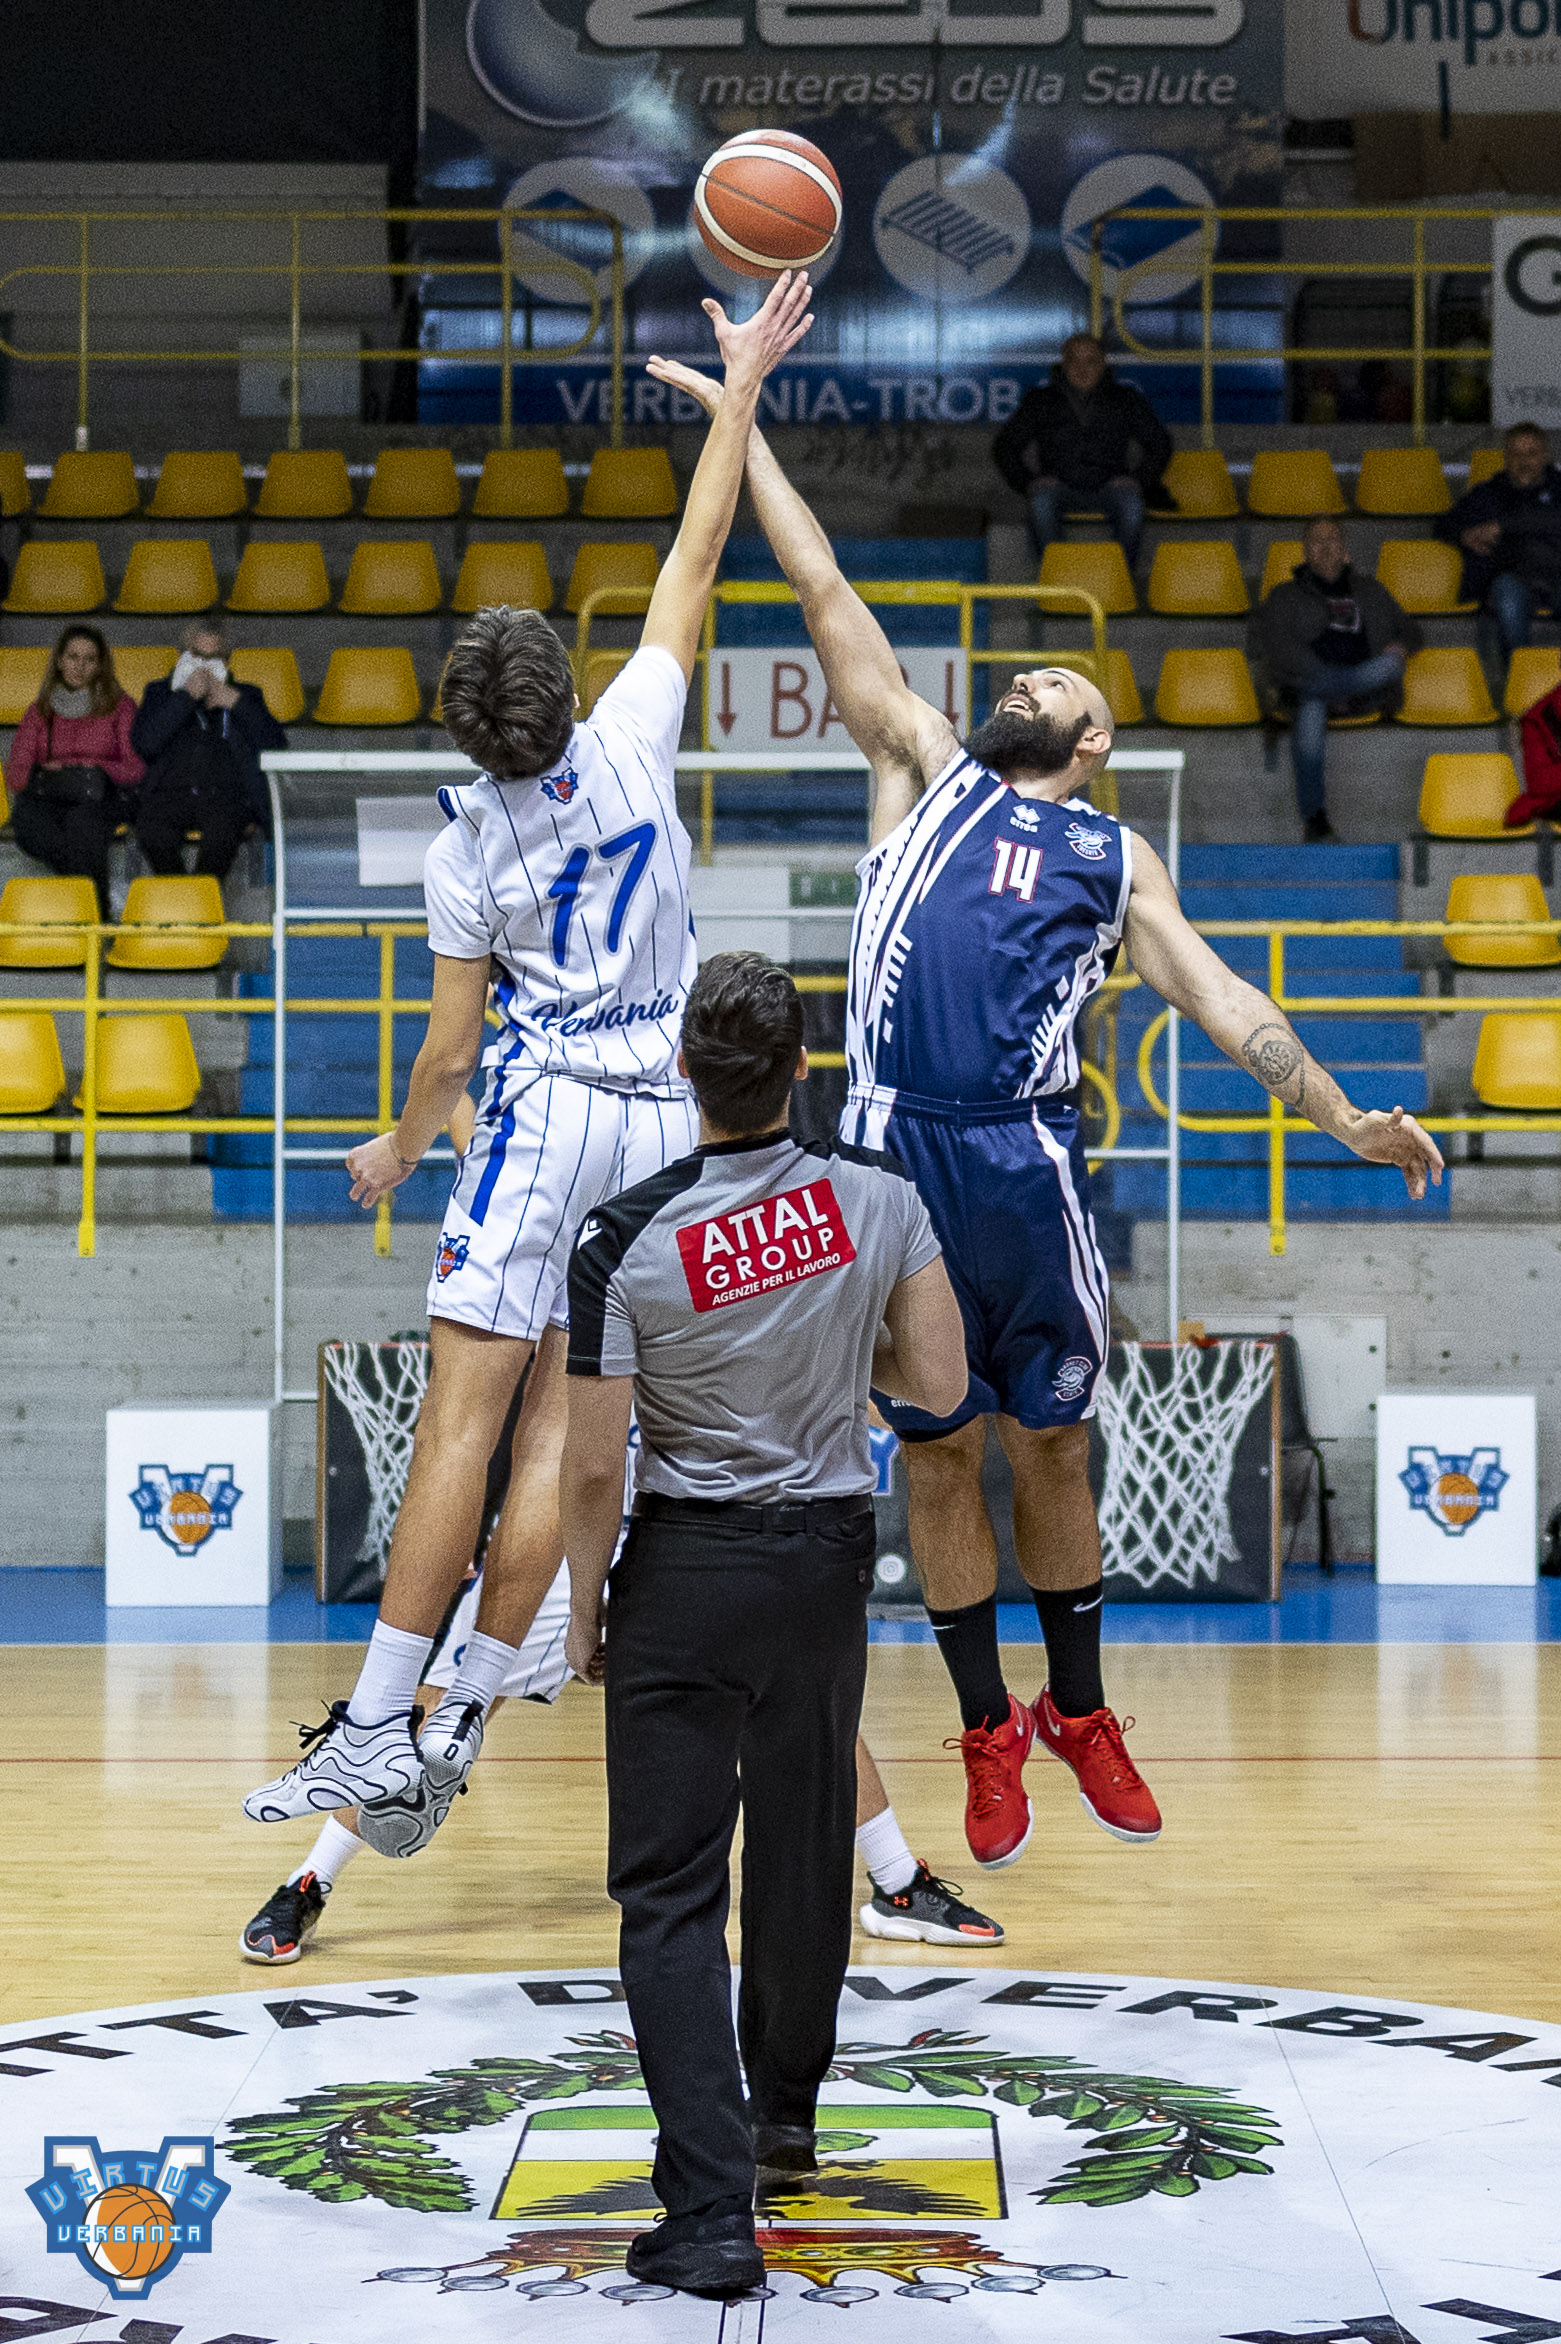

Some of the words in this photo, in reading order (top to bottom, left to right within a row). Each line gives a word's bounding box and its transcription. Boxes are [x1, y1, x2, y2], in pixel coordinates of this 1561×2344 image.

[1347, 0, 1561, 67] Unipo
[701, 70, 934, 103] materassi
[951, 65, 1066, 102] della
[1083, 65, 1239, 103] Salute
[546, 819, 656, 967] 17
[988, 837, 1044, 904] 14
[702, 1188, 829, 1265] ATTAL
[705, 1227, 834, 1290] GROUP
[712, 1283, 760, 1306] AGENZIE
[762, 1273, 783, 1289] PER
[785, 1270, 796, 1281] IL
[797, 1252, 841, 1278] LAVORO
